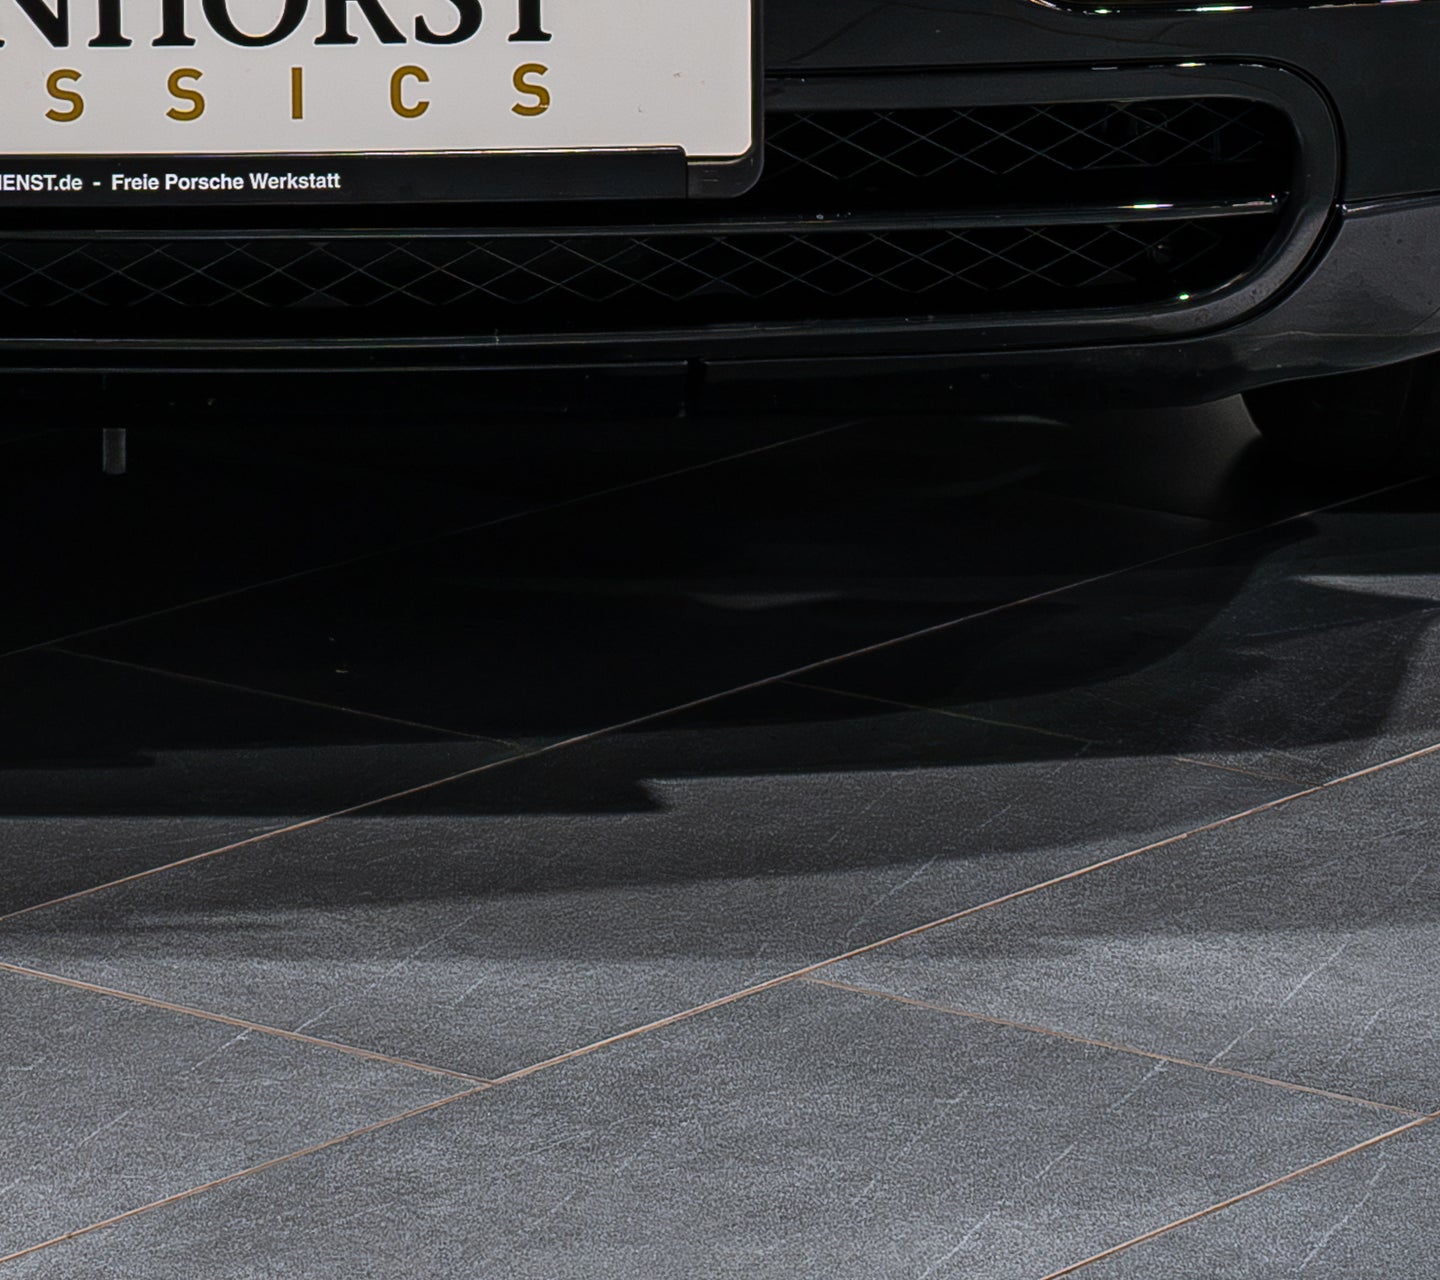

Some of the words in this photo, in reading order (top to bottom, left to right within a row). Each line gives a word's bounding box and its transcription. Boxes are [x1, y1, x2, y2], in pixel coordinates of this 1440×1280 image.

[111, 173, 160, 191] Freie
[164, 173, 245, 191] Porsche
[248, 172, 342, 190] Werkstatt
